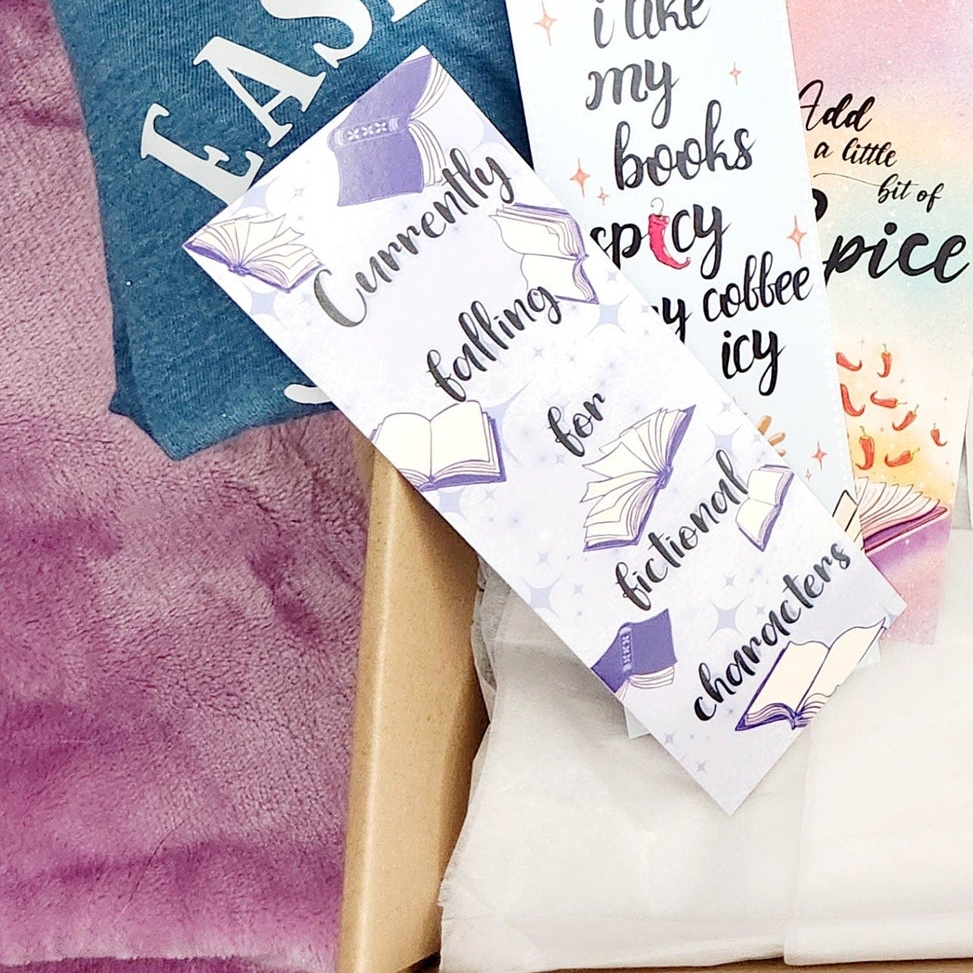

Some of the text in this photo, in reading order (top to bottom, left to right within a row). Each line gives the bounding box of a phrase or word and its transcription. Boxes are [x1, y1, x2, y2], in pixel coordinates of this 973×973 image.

[585, 58, 680, 129] my
[799, 79, 876, 132] Add
[614, 99, 756, 191] books
[813, 137, 898, 167] a little
[877, 173, 944, 213] bit of
[313, 148, 515, 327] Currently
[812, 188, 970, 287] pice
[702, 250, 815, 323] coffee
[426, 285, 562, 403] falling
[721, 328, 787, 396] icy
[547, 393, 605, 457] for
[615, 449, 748, 611] fictional
[693, 540, 852, 722] characters
